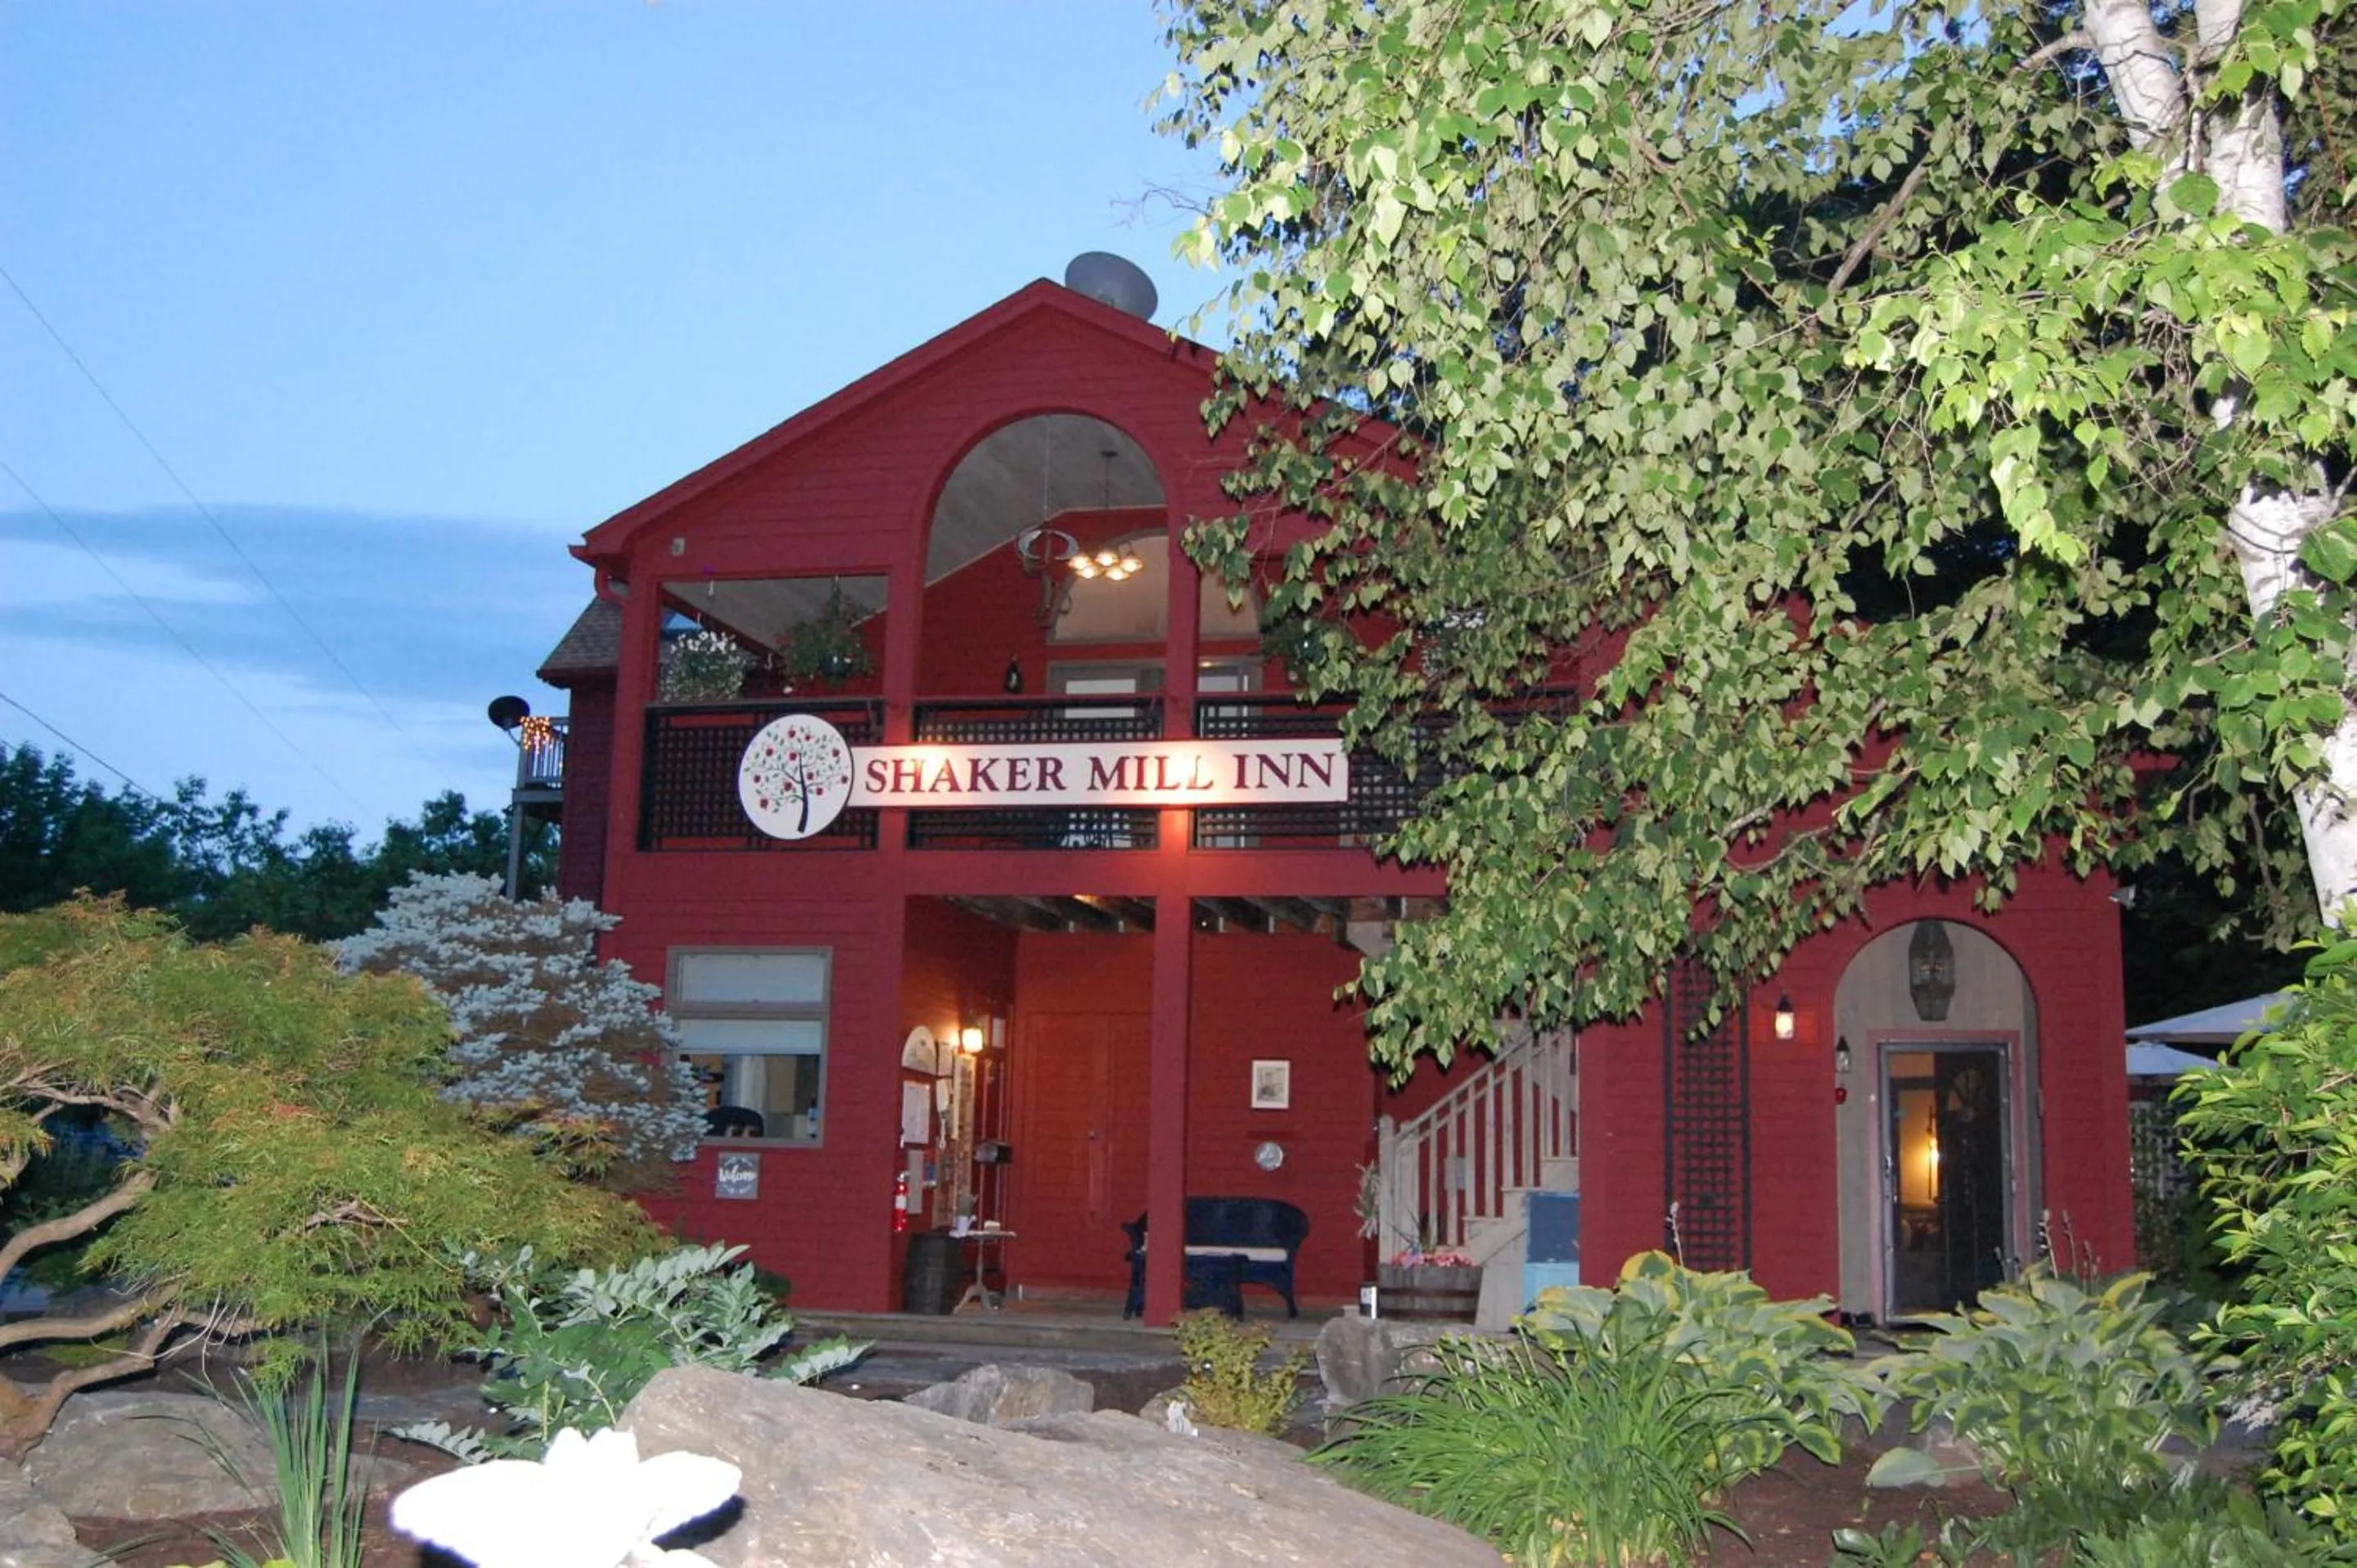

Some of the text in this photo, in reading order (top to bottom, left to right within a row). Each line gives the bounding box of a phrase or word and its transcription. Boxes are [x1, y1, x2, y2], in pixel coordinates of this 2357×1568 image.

[865, 753, 1336, 793] SHAKER MILL INN
